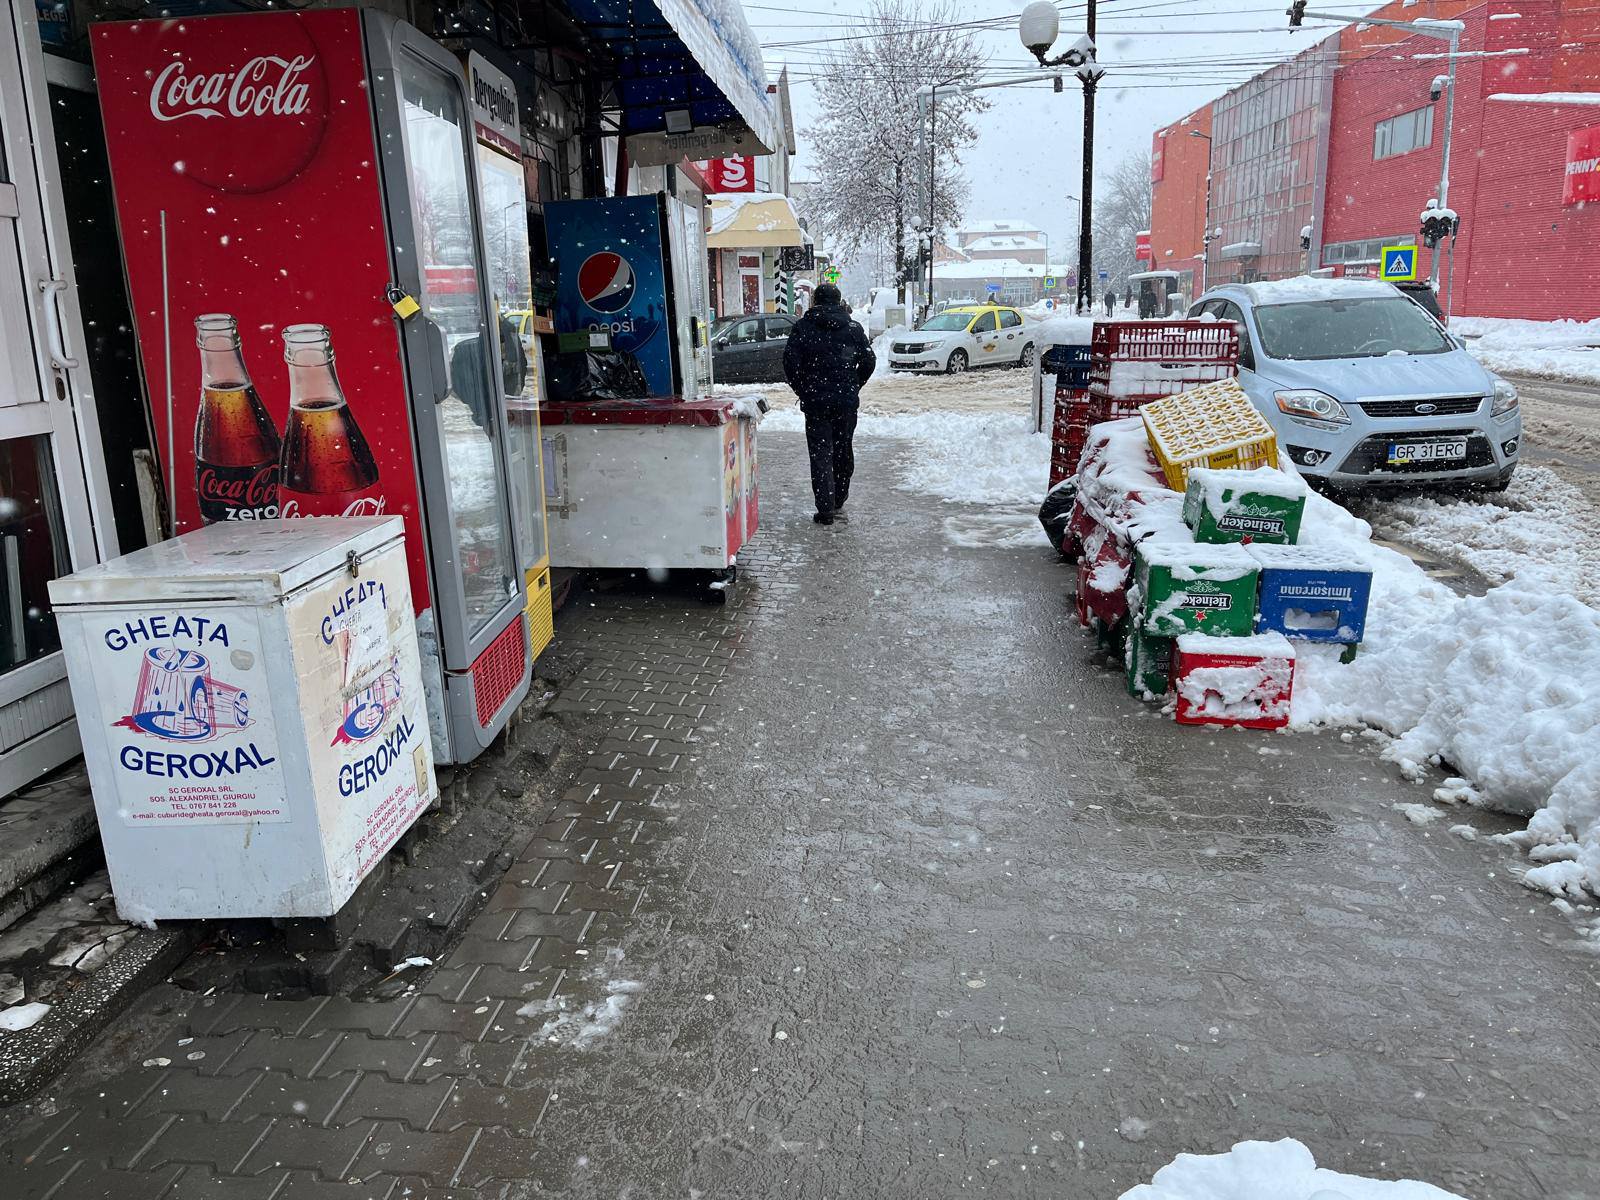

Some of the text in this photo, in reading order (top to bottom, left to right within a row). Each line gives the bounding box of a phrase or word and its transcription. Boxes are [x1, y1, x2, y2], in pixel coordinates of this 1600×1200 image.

[150, 55, 315, 122] Coca-Cola
[472, 66, 516, 128] Bergenbier
[1565, 157, 1600, 176] PENNY
[1396, 443, 1464, 459] GR 31 ERC
[225, 505, 279, 521] zero
[1221, 517, 1282, 533] Heineken
[120, 743, 275, 779] GEROXAL
[338, 714, 415, 797] GEROXAL
[180, 786, 217, 794] GEROXAL
[223, 793, 256, 801] GIURGIU
